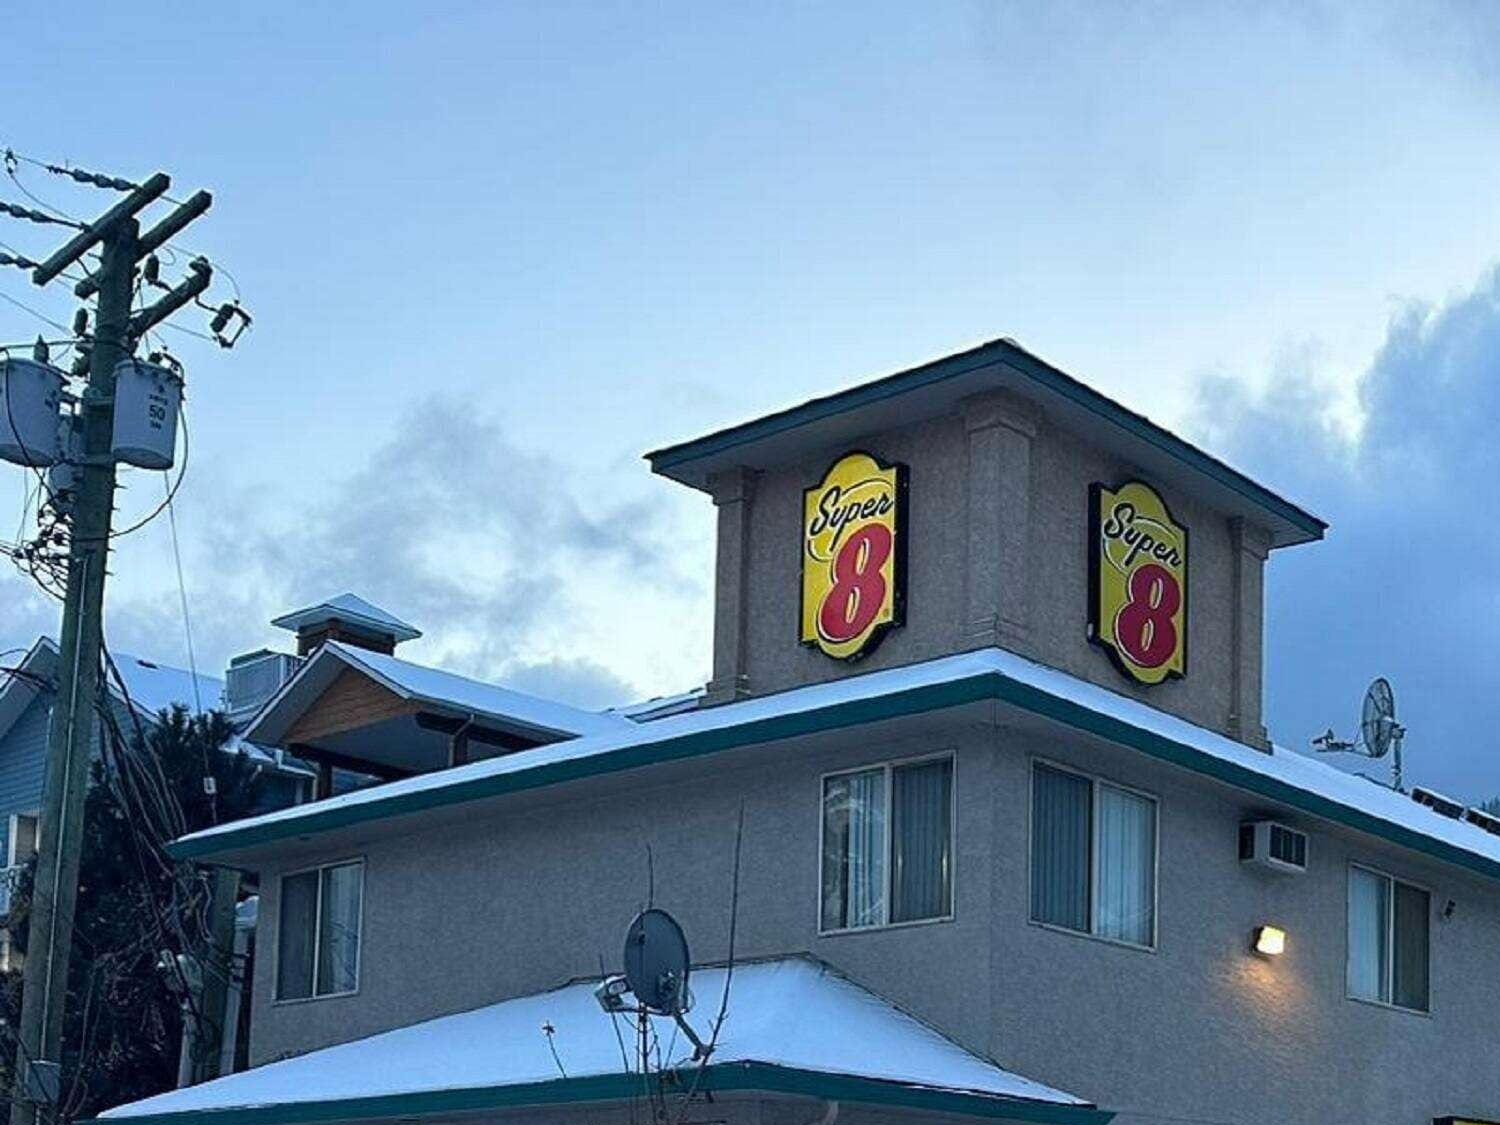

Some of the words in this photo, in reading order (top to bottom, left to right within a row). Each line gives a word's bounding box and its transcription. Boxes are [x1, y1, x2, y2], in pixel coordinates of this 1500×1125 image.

[809, 485, 894, 552] Super
[1103, 502, 1182, 567] Super
[817, 522, 893, 644] 8
[1114, 563, 1182, 669] 8
